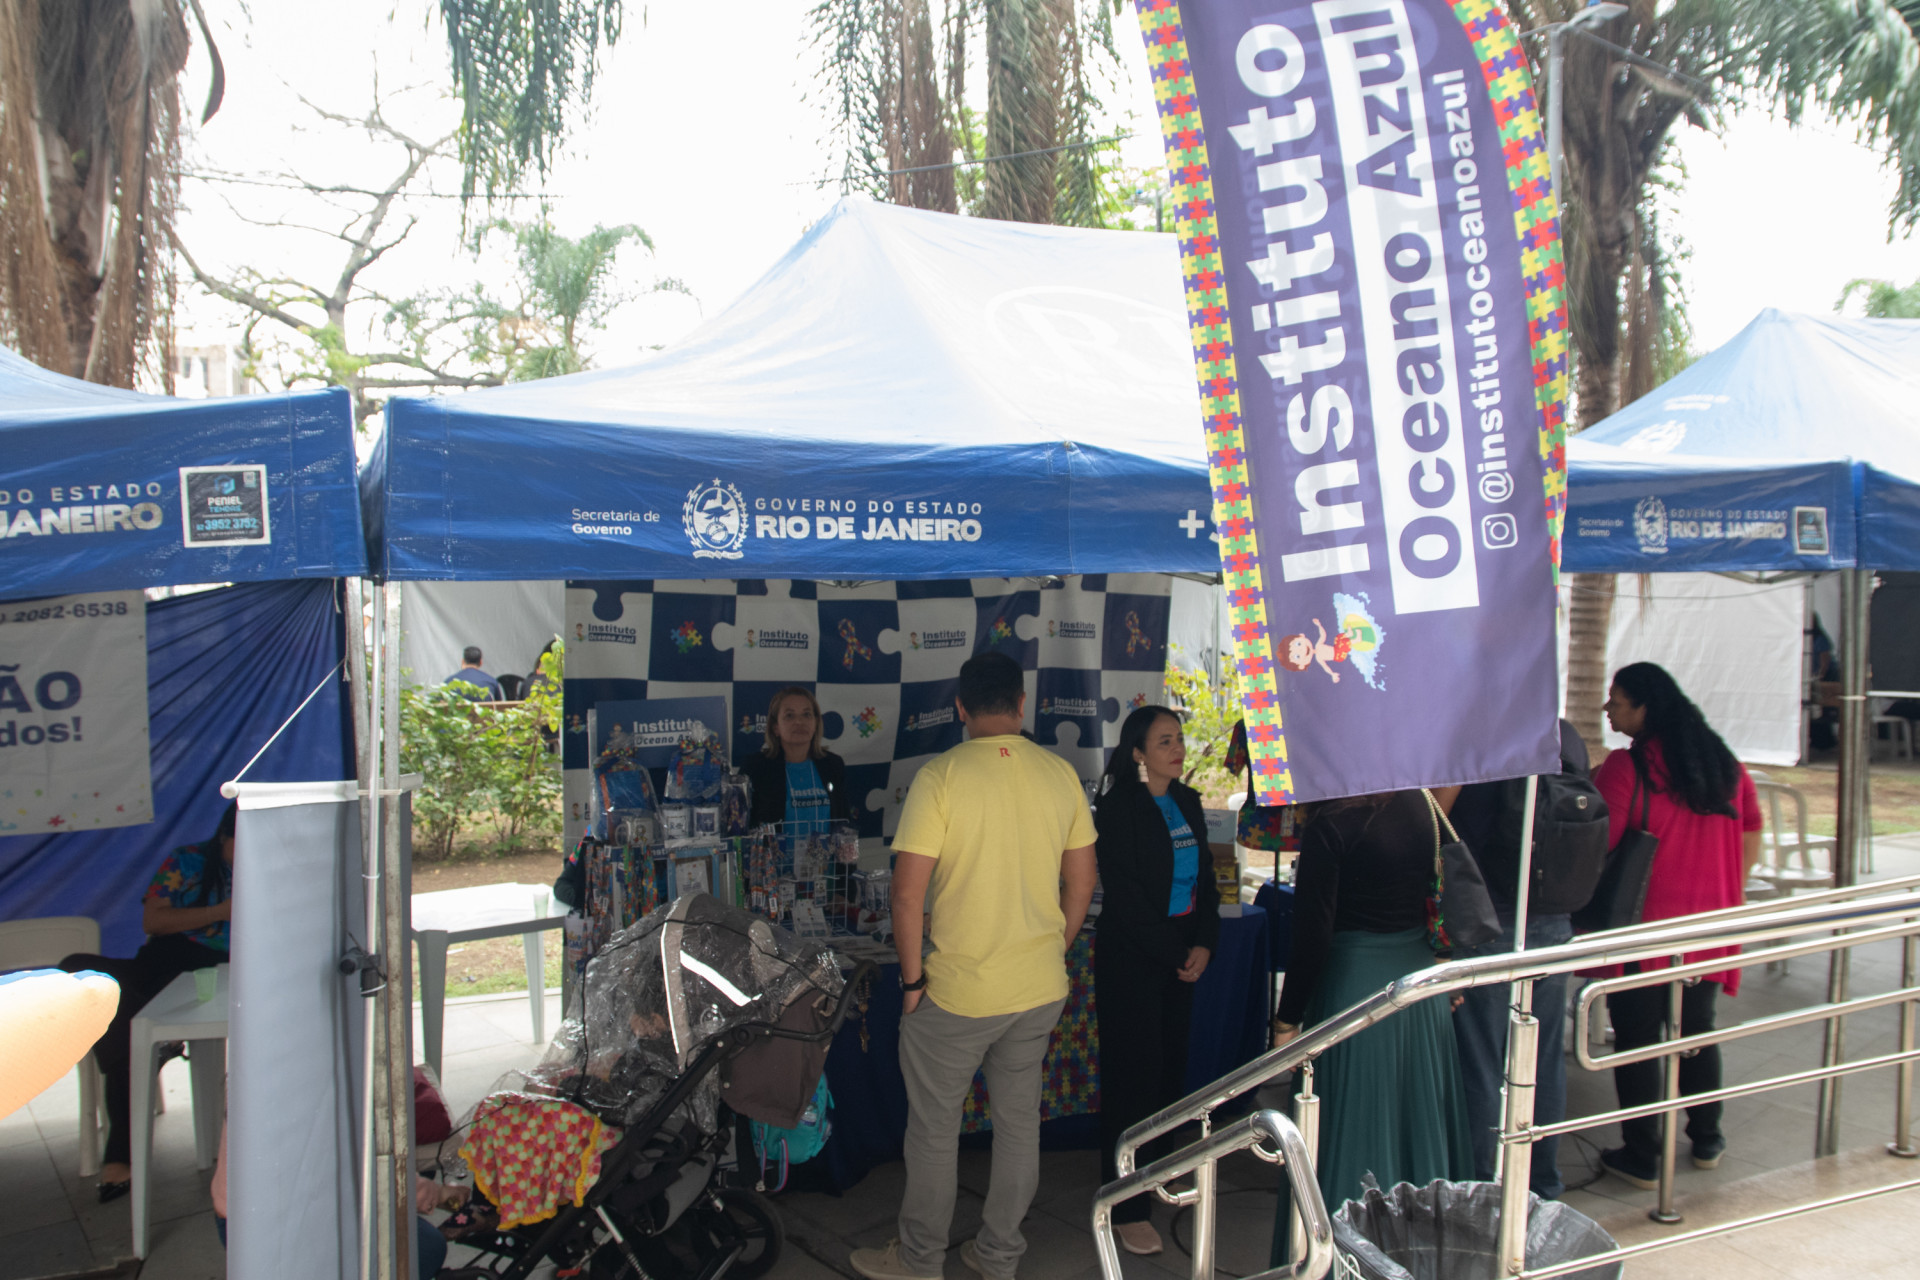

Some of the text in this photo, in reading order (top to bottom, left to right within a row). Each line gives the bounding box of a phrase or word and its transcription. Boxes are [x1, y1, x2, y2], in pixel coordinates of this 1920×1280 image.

[1433, 69, 1515, 503] @institutoceanoazul
[1330, 9, 1462, 579] Oceano Azul
[1227, 24, 1371, 582] Instituto
[51, 482, 161, 503] ESTADO
[208, 496, 243, 506] PENIEL
[755, 498, 982, 515] GOVERNO DO ESTADO
[572, 508, 660, 522] Secretaria de
[1670, 508, 1788, 520] GOVERNO DO ESTADO
[205, 518, 230, 530] 3952
[232, 518, 257, 529] 3752
[1578, 517, 1614, 527] Secretaria
[572, 523, 632, 535] Governo
[756, 515, 982, 542] RIO DE JANEIRO
[1578, 528, 1610, 537] Governo
[1670, 521, 1700, 538] RIO
[1702, 522, 1723, 538] DE
[1726, 522, 1786, 539] JANEIRO
[14, 602, 127, 622] 2082-6538
[588, 624, 636, 635] Instituto
[1060, 621, 1095, 630] Instituto
[759, 630, 808, 640] Instituto
[922, 630, 966, 640] Instituto
[760, 640, 807, 649] Oceano Azul
[1054, 697, 1097, 708] Instituto
[919, 706, 954, 721] Instituto
[637, 736, 673, 745] Oceano
[1174, 838, 1198, 849] Ocean
